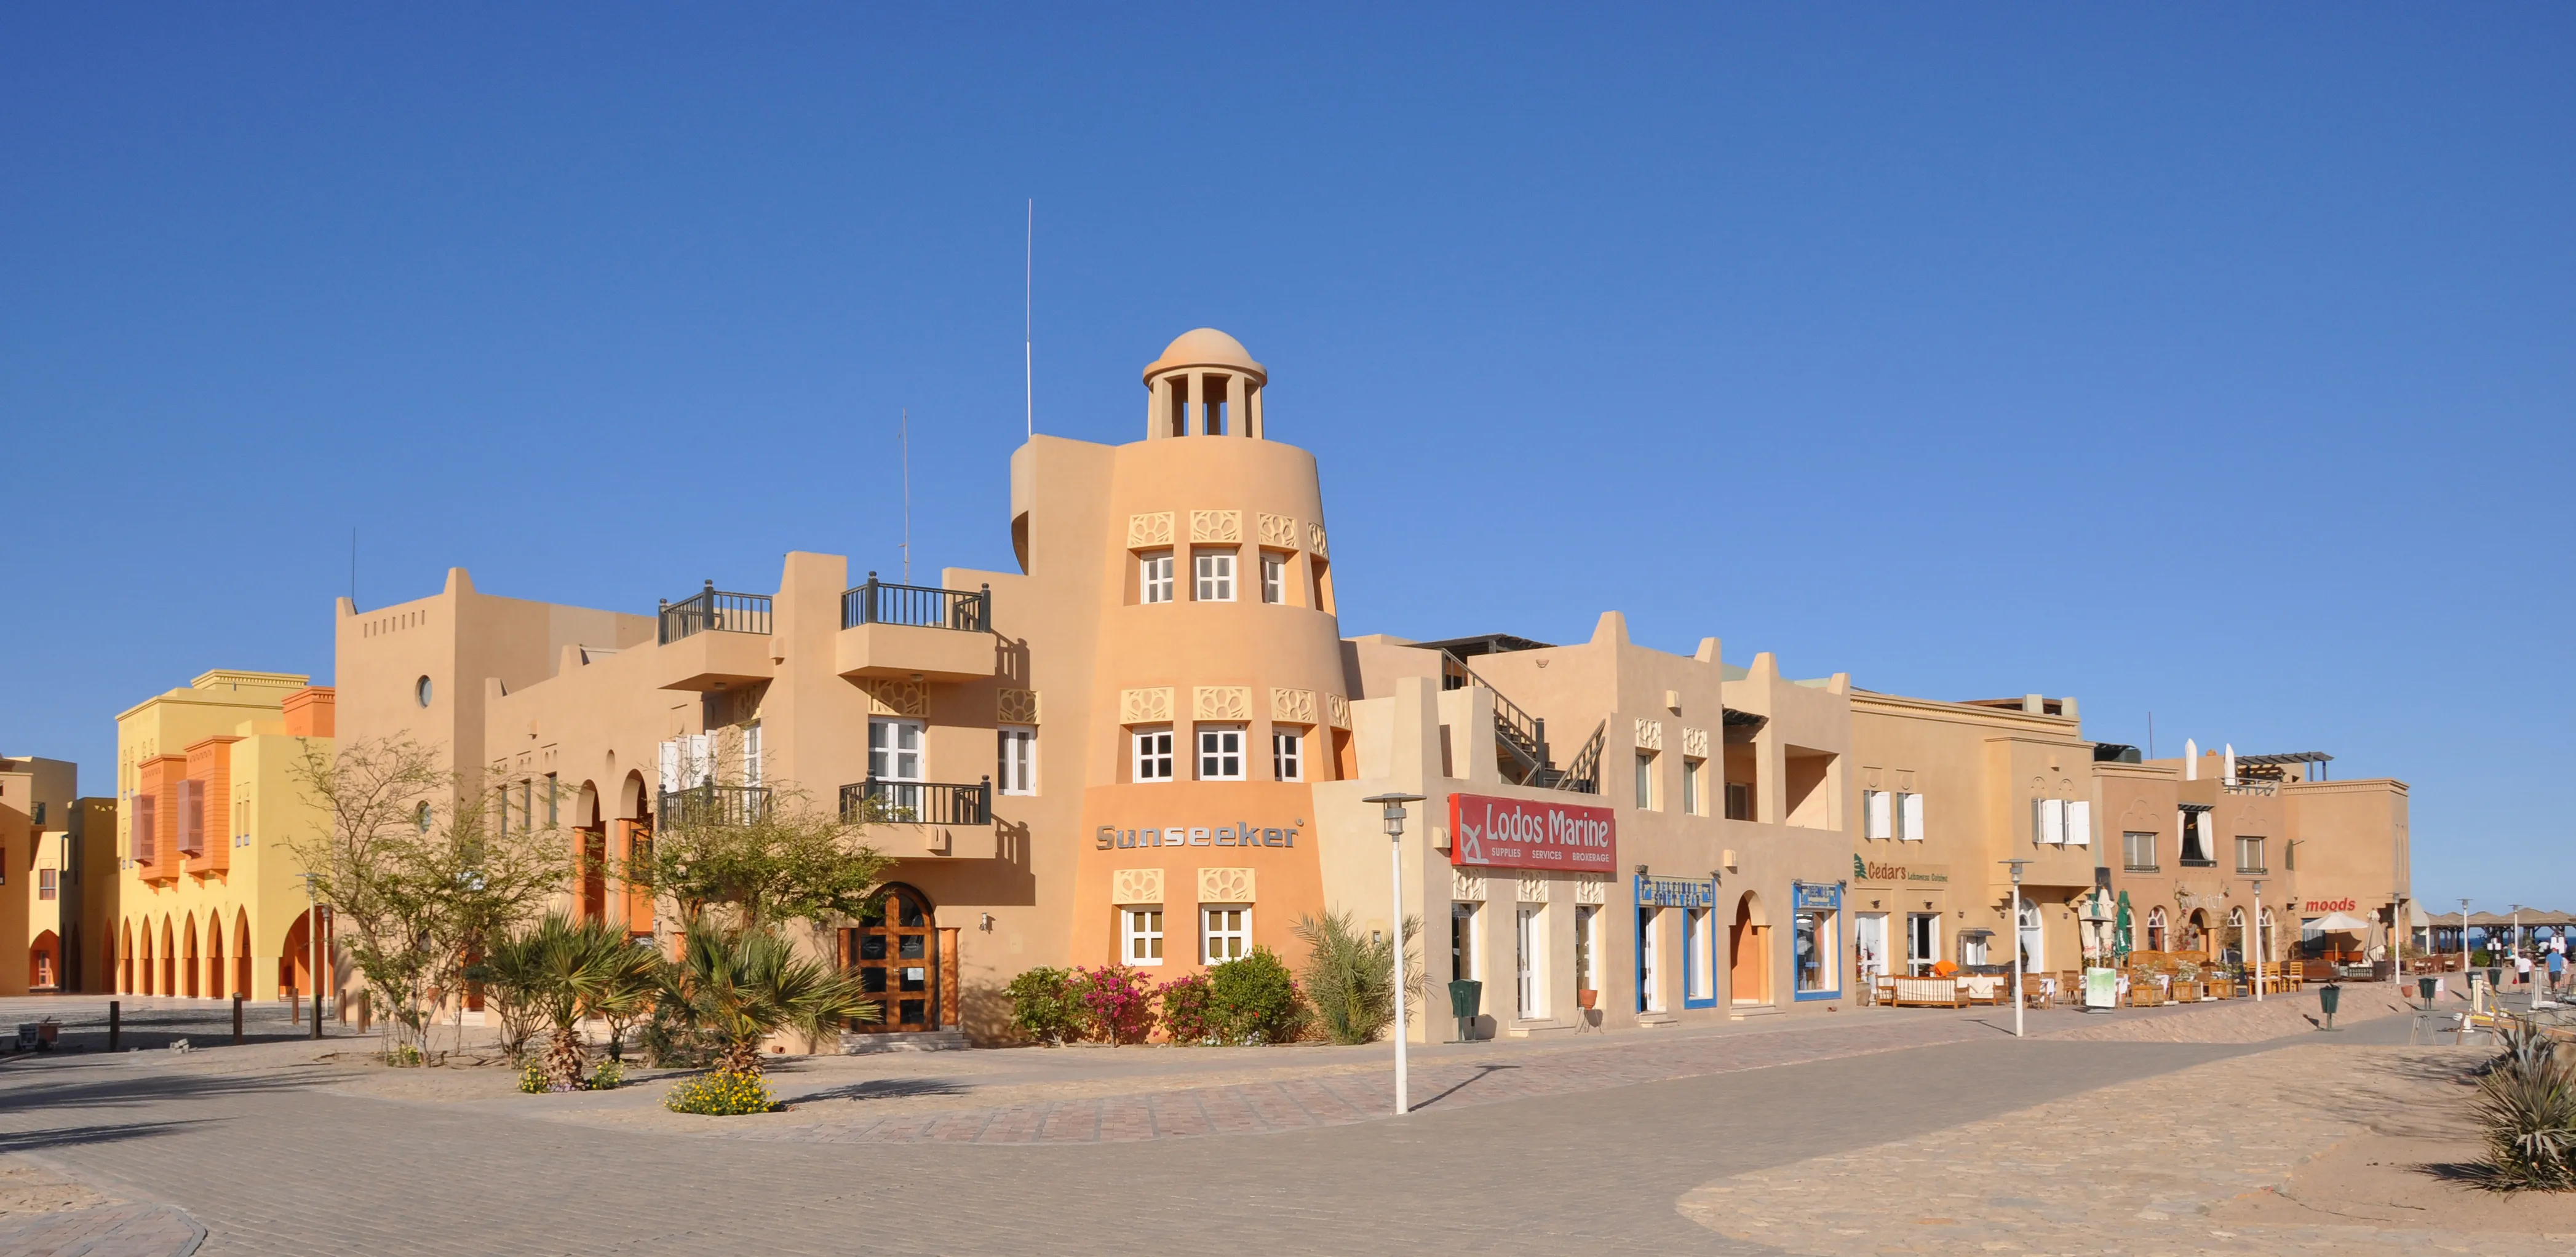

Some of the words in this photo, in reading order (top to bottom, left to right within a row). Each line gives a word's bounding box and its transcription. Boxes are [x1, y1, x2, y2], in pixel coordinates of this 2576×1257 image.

[1487, 803, 1543, 844] Lodos
[1548, 809, 1608, 848] Marine
[1096, 822, 1298, 851] Sunseeker
[1492, 847, 1521, 858] SUPPLIES
[1532, 849, 1562, 860] SERVICES
[1572, 852, 1609, 862] BROKERAGE
[1868, 861, 1907, 880] Cedars
[2305, 897, 2356, 912] moods
